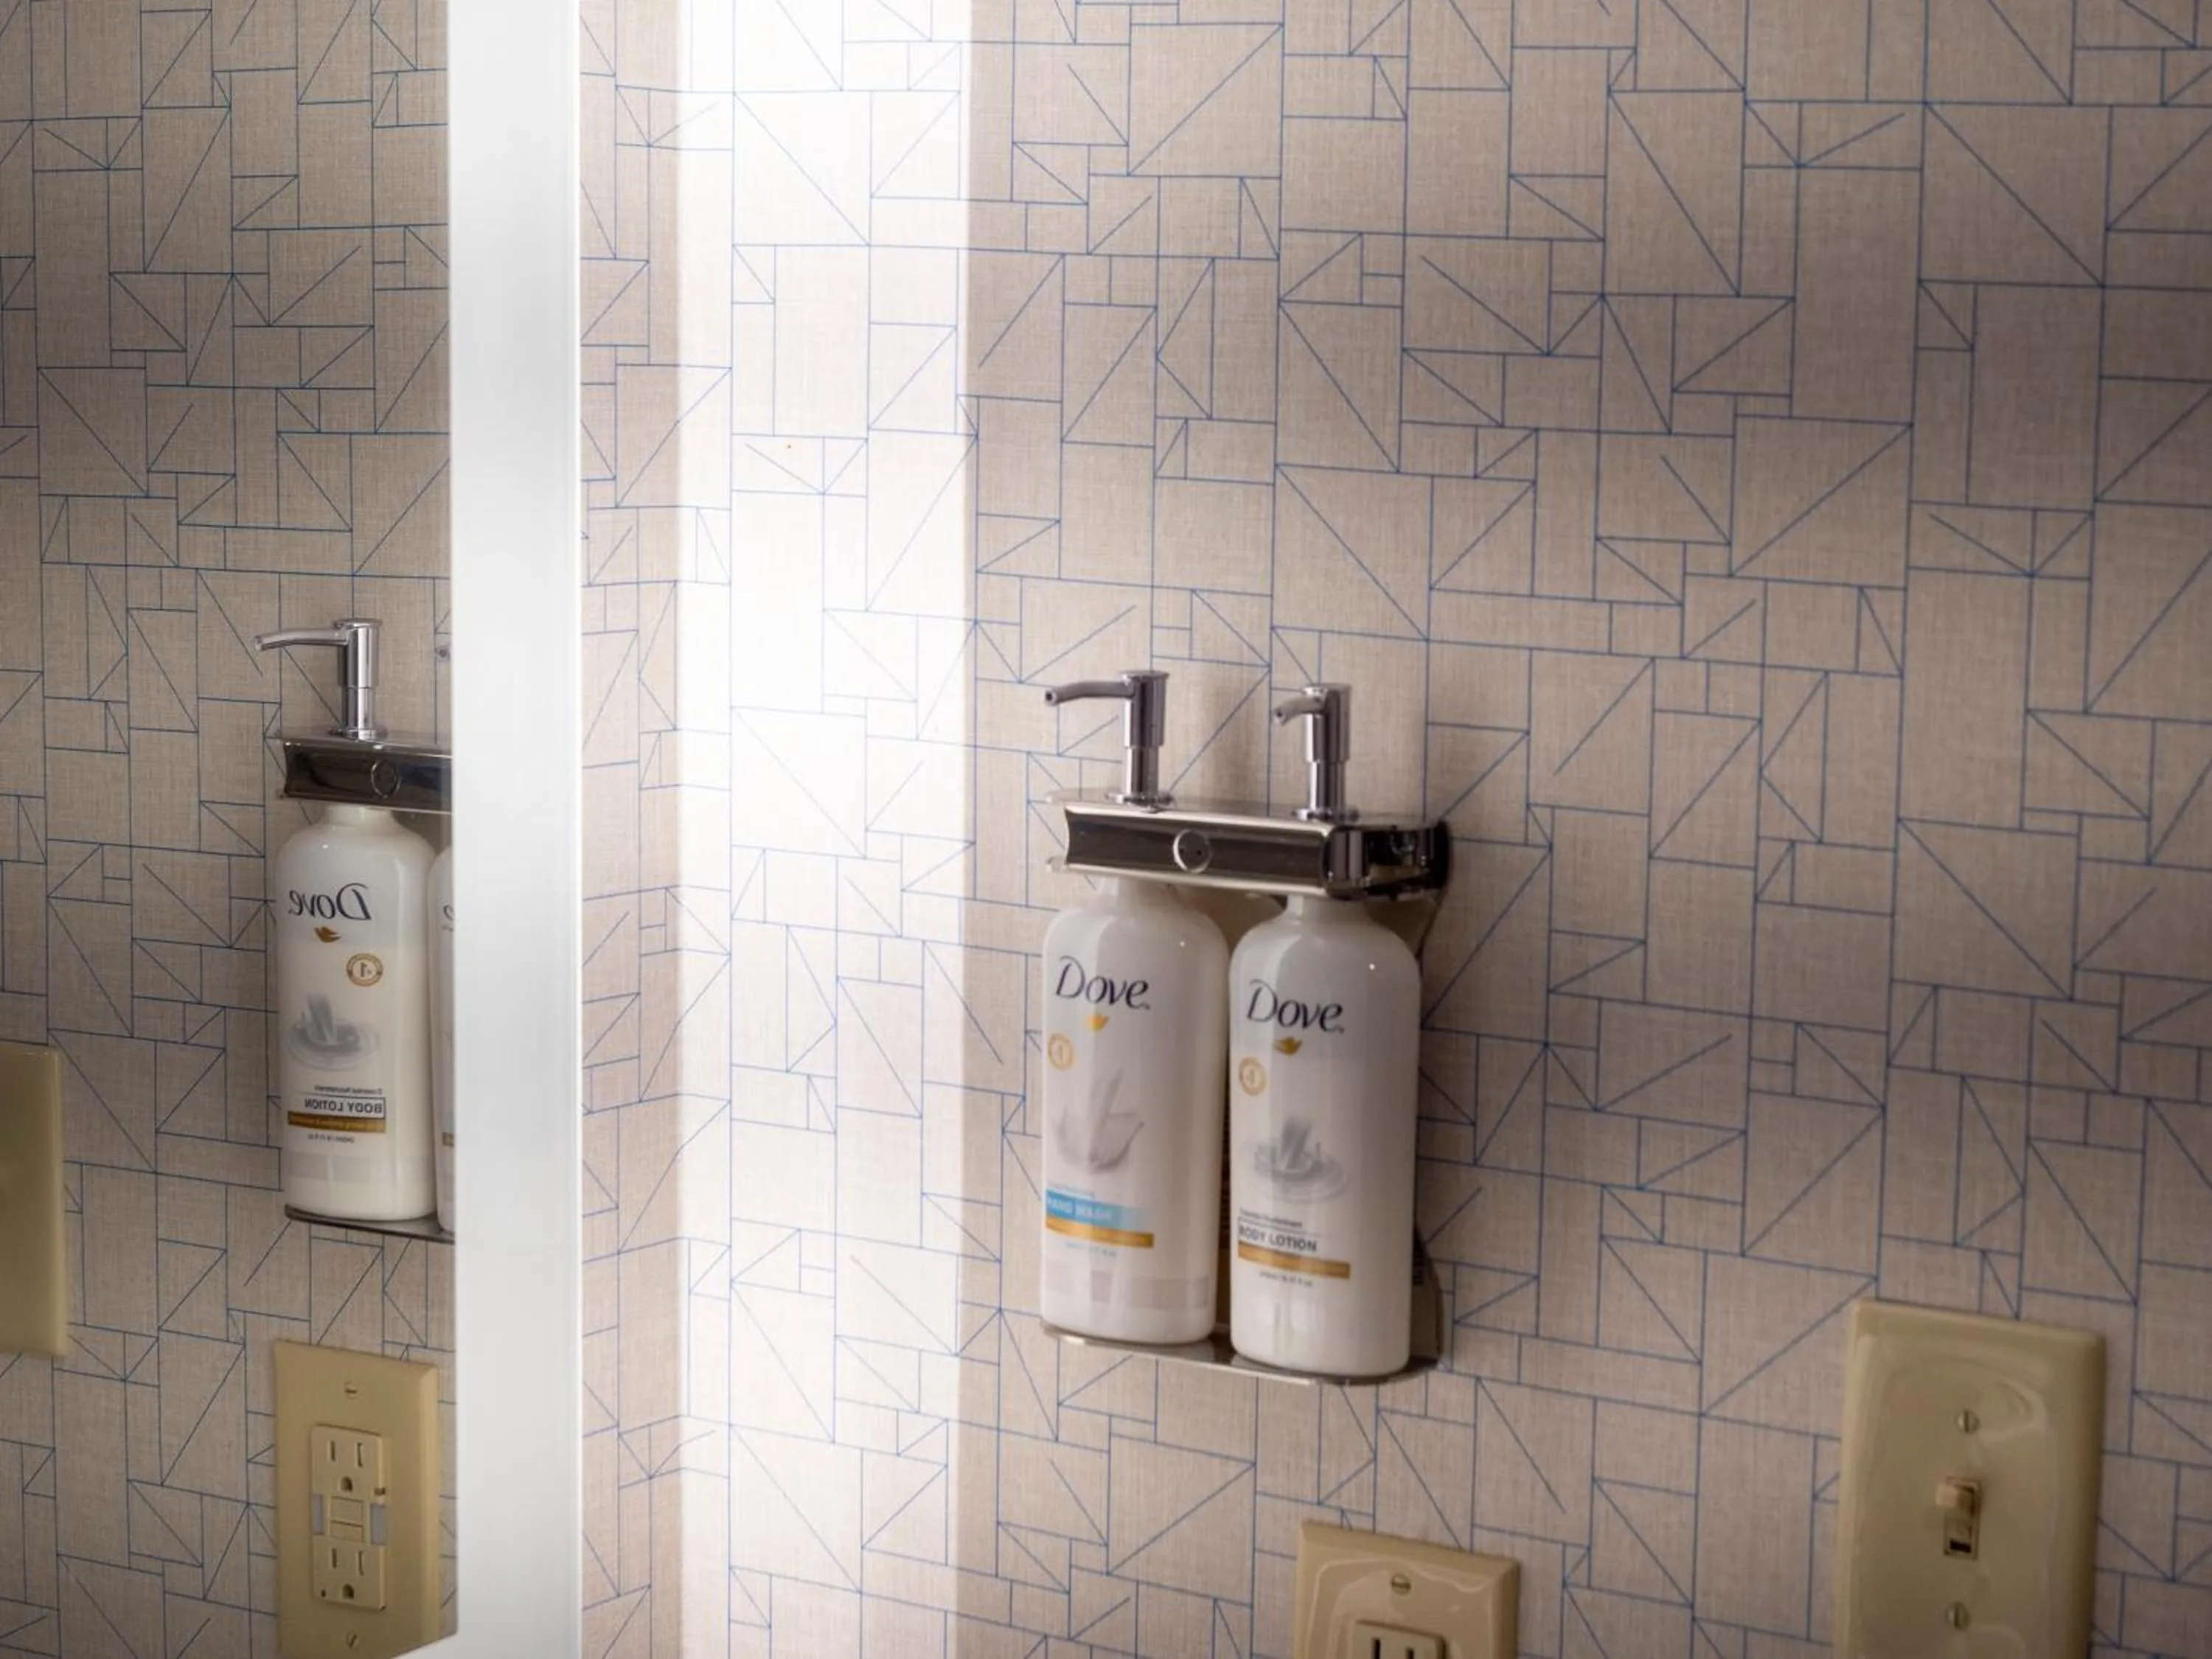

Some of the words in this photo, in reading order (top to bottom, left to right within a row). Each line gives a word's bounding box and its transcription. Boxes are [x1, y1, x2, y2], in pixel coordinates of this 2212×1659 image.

[1055, 956, 1149, 1010] Dove
[1246, 978, 1343, 1032] Dove
[1238, 1224, 1267, 1242] BODY
[1269, 1234, 1317, 1252] LOTION
